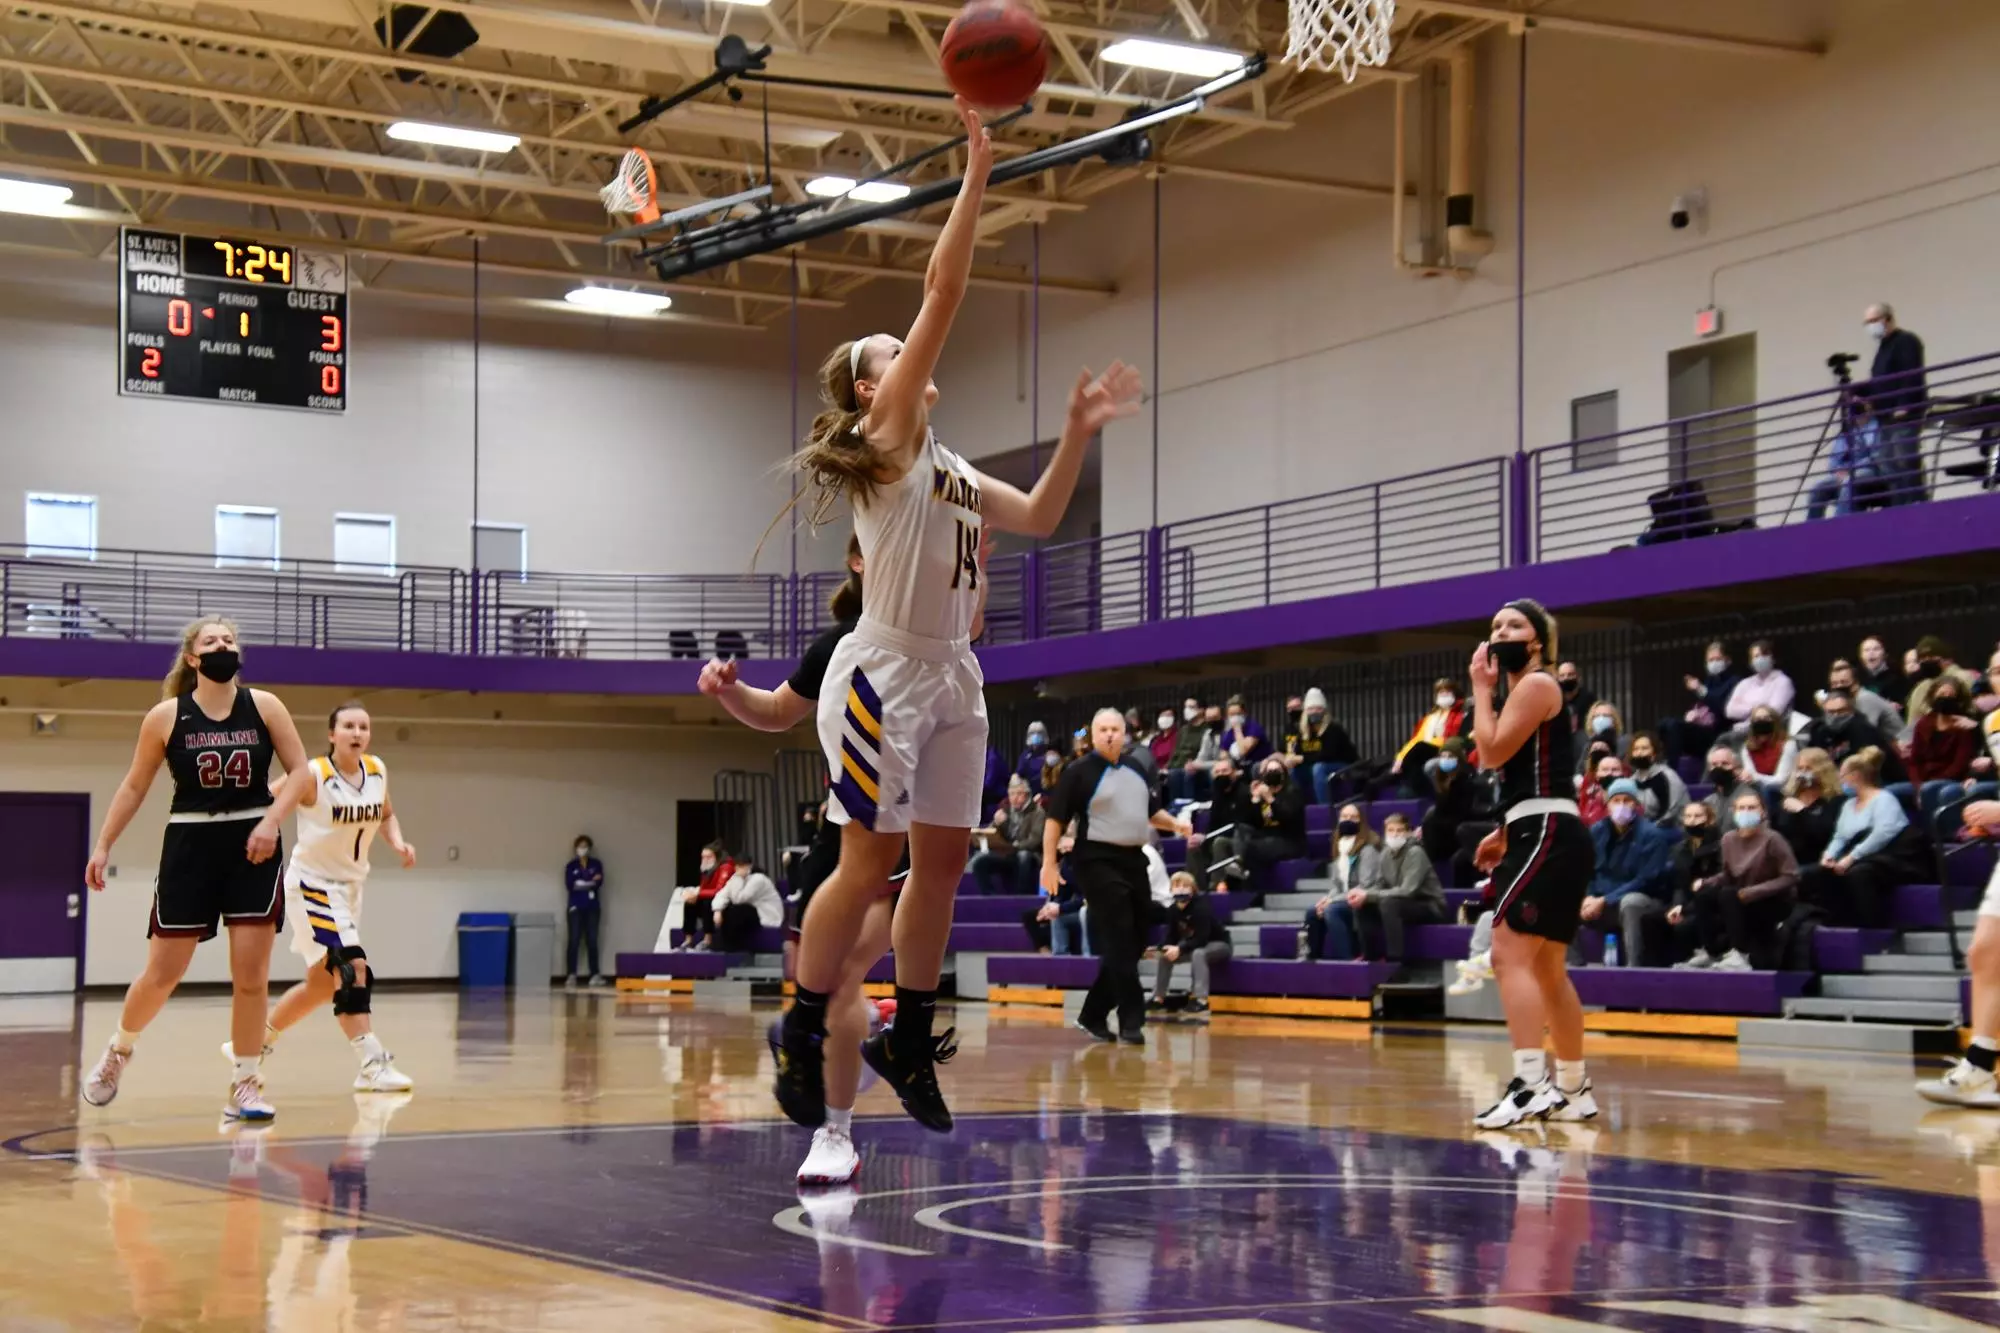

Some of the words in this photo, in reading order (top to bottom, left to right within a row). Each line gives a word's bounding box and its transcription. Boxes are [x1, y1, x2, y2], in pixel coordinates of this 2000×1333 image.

[214, 241, 291, 283] 7:24
[136, 273, 185, 295] HOME
[218, 292, 258, 307] PERIOD
[287, 291, 338, 311] GUEST
[168, 299, 192, 336] 0
[240, 312, 249, 337] 1
[127, 333, 164, 347] FOULS
[321, 315, 342, 351] 3
[200, 341, 241, 355] PLAYER
[247, 345, 275, 358] FOUL
[309, 351, 343, 364] FOULS
[141, 348, 162, 378] 2
[127, 378, 165, 393] SCORE
[321, 365, 341, 394] 0
[218, 387, 256, 401] MATCH
[308, 395, 342, 409] SCORE
[951, 519, 979, 590] 14
[184, 729, 259, 749] HAMLINE
[196, 749, 252, 788] 24
[353, 827, 364, 862] 1
